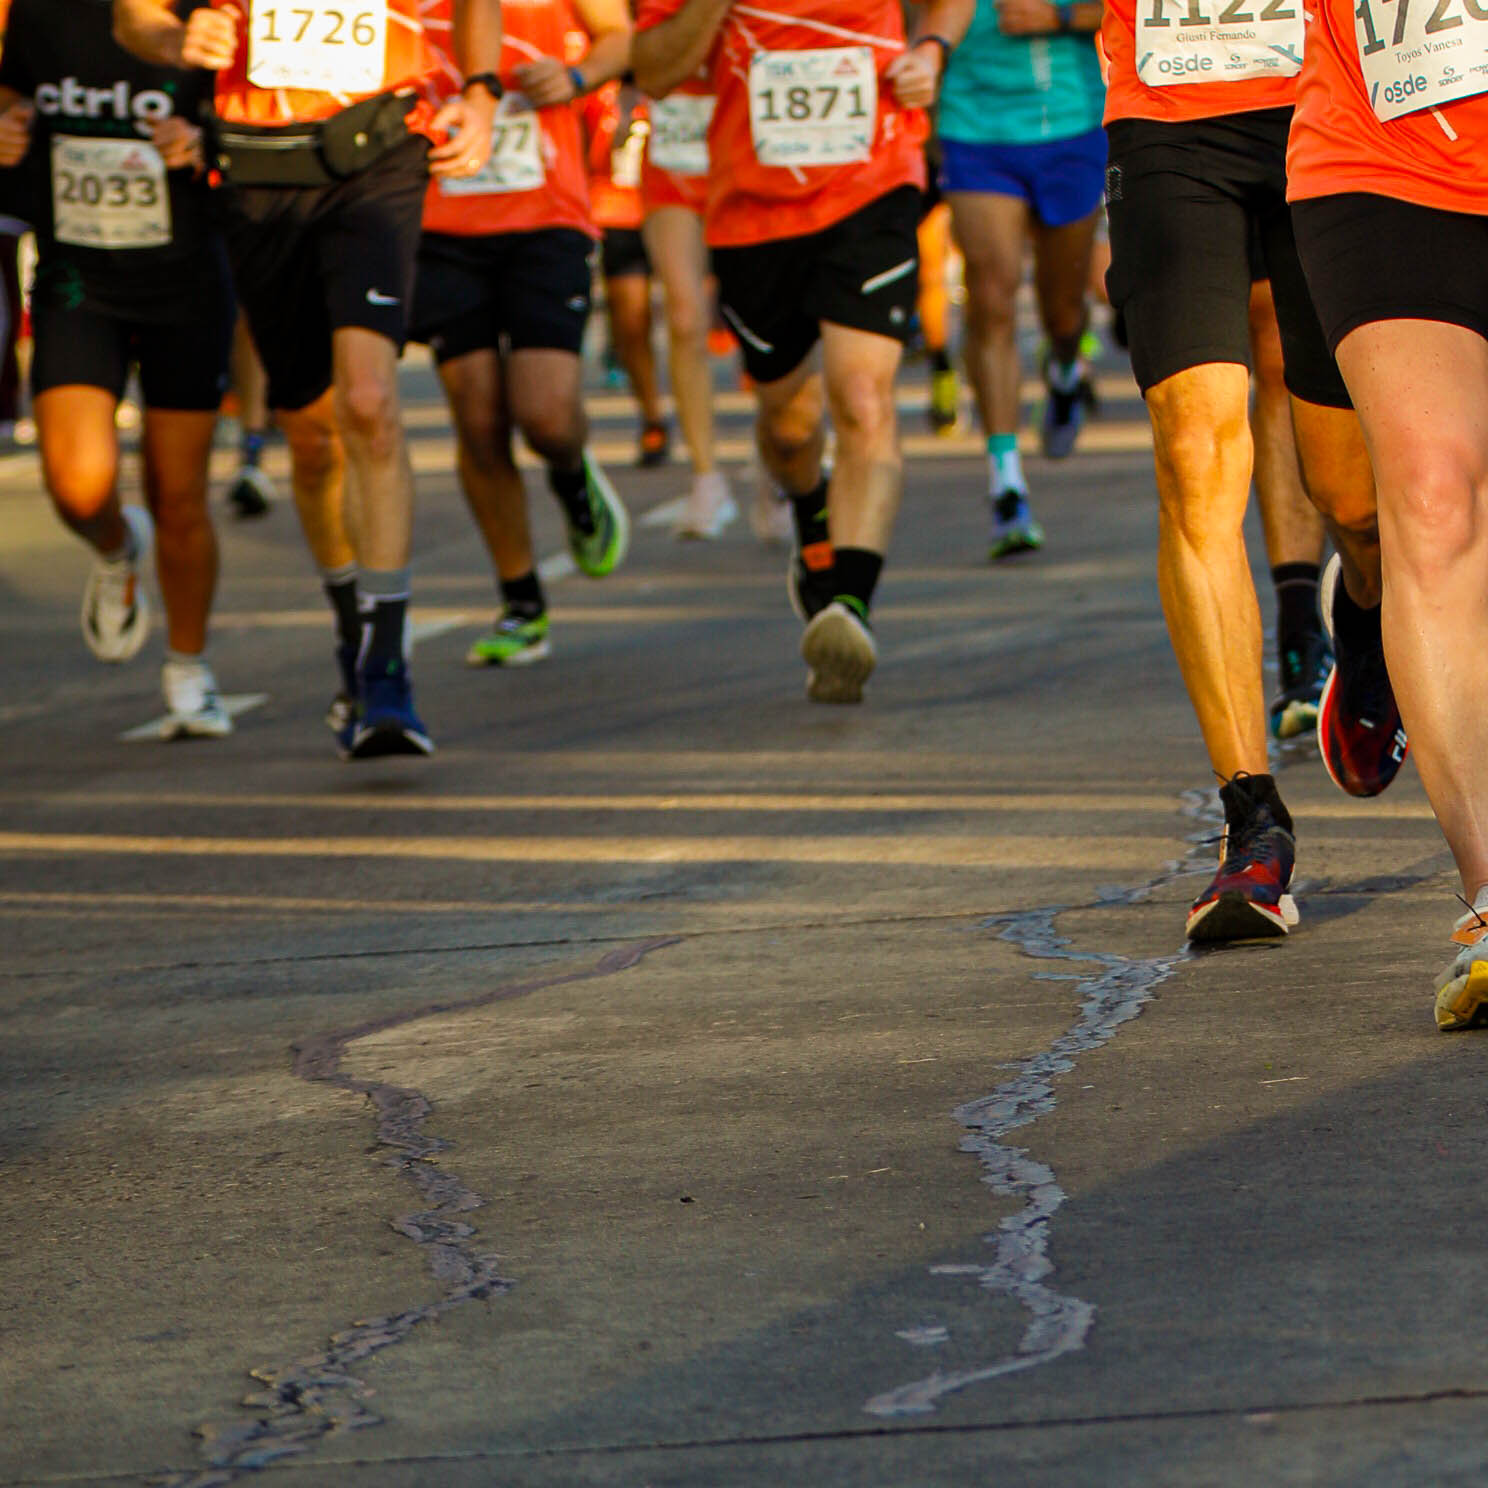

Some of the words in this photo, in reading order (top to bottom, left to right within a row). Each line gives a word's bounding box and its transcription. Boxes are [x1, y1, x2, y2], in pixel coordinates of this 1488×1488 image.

[260, 8, 376, 46] 1726
[1176, 31, 1207, 43] Giusti
[1158, 53, 1213, 75] osde
[1395, 46, 1422, 64] Toyos
[1423, 37, 1463, 55] Vanesa
[757, 84, 867, 122] 1871
[1384, 72, 1427, 103] osde
[57, 170, 158, 207] 2033
